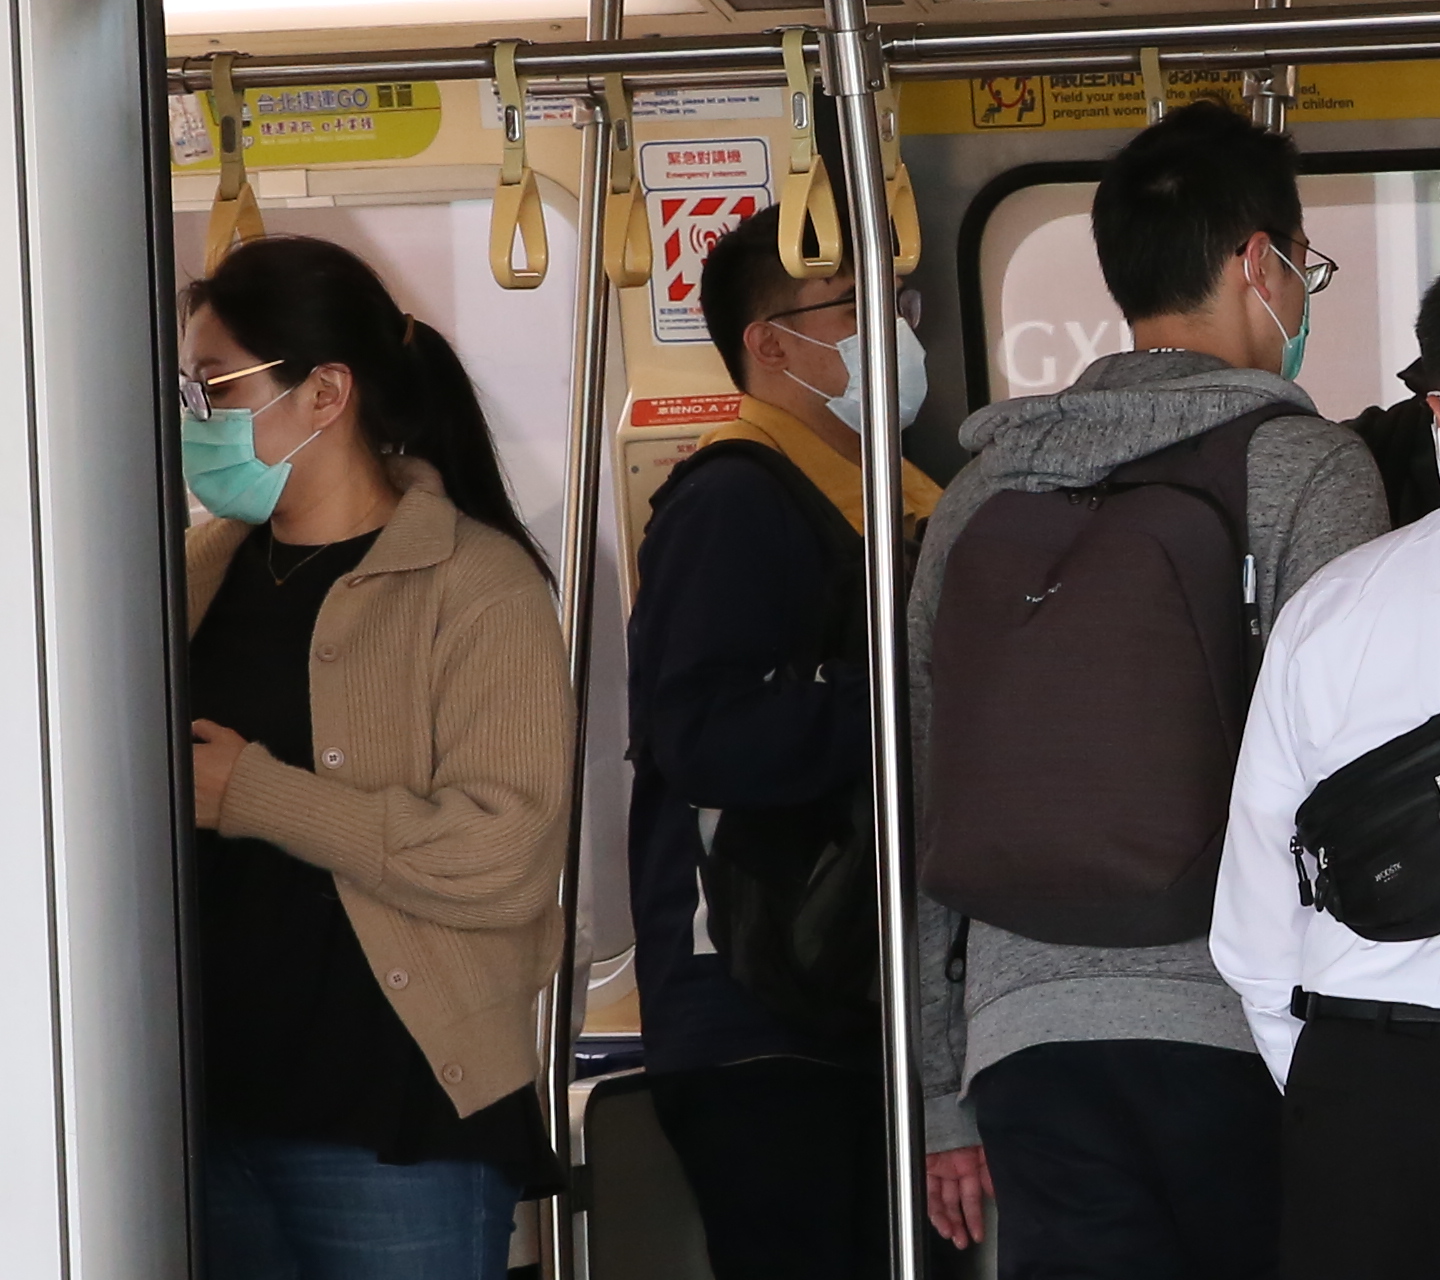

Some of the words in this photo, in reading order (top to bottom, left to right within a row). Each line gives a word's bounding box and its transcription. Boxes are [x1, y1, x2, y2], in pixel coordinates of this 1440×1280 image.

[1052, 92, 1082, 103] Yield
[1086, 93, 1115, 104] your
[1053, 107, 1111, 120] pregnant
[1302, 98, 1354, 109] children
